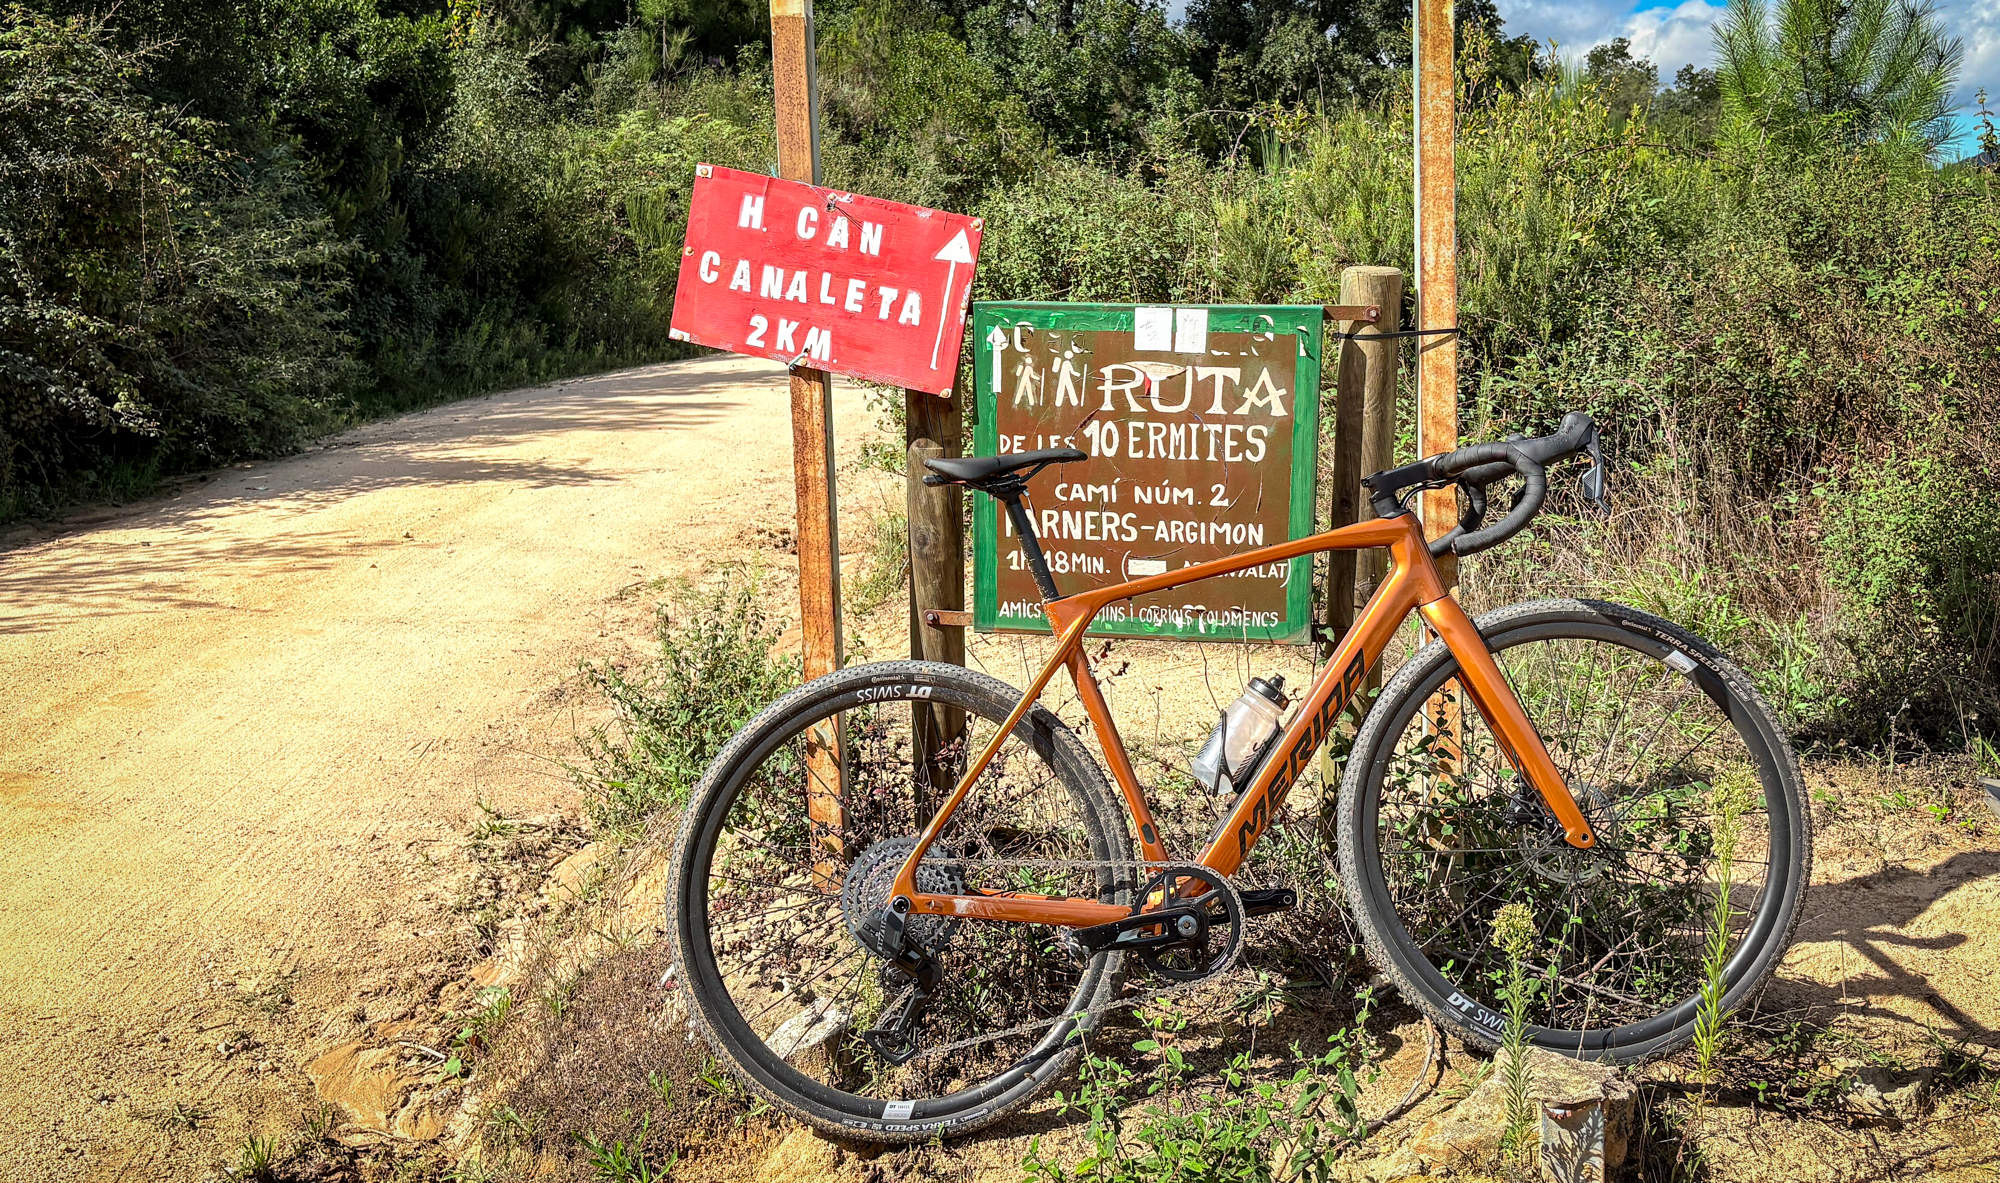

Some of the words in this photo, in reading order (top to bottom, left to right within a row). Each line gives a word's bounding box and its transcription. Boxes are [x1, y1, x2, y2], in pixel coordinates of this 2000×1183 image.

[738, 195, 767, 232] H.
[797, 206, 883, 256] CAN
[699, 251, 921, 326] CANALETA
[1097, 364, 1288, 416] RUTA
[999, 434, 1026, 454] DE
[1083, 420, 1119, 457] 10
[1128, 421, 1268, 462] ERMITES
[1055, 478, 1117, 504] CAMÍ
[1134, 479, 1202, 505] NÚM.
[1210, 484, 1229, 507] 2
[1655, 630, 1688, 651] TERRA
[1688, 649, 1720, 672] SPEED
[856, 685, 902, 703] SWISS
[905, 685, 932, 699] DT
[1238, 648, 1365, 858] MERIDA
[1447, 992, 1475, 1012] DT
[1473, 1009, 1505, 1031] SWI
[886, 1124, 920, 1132] SPEED
